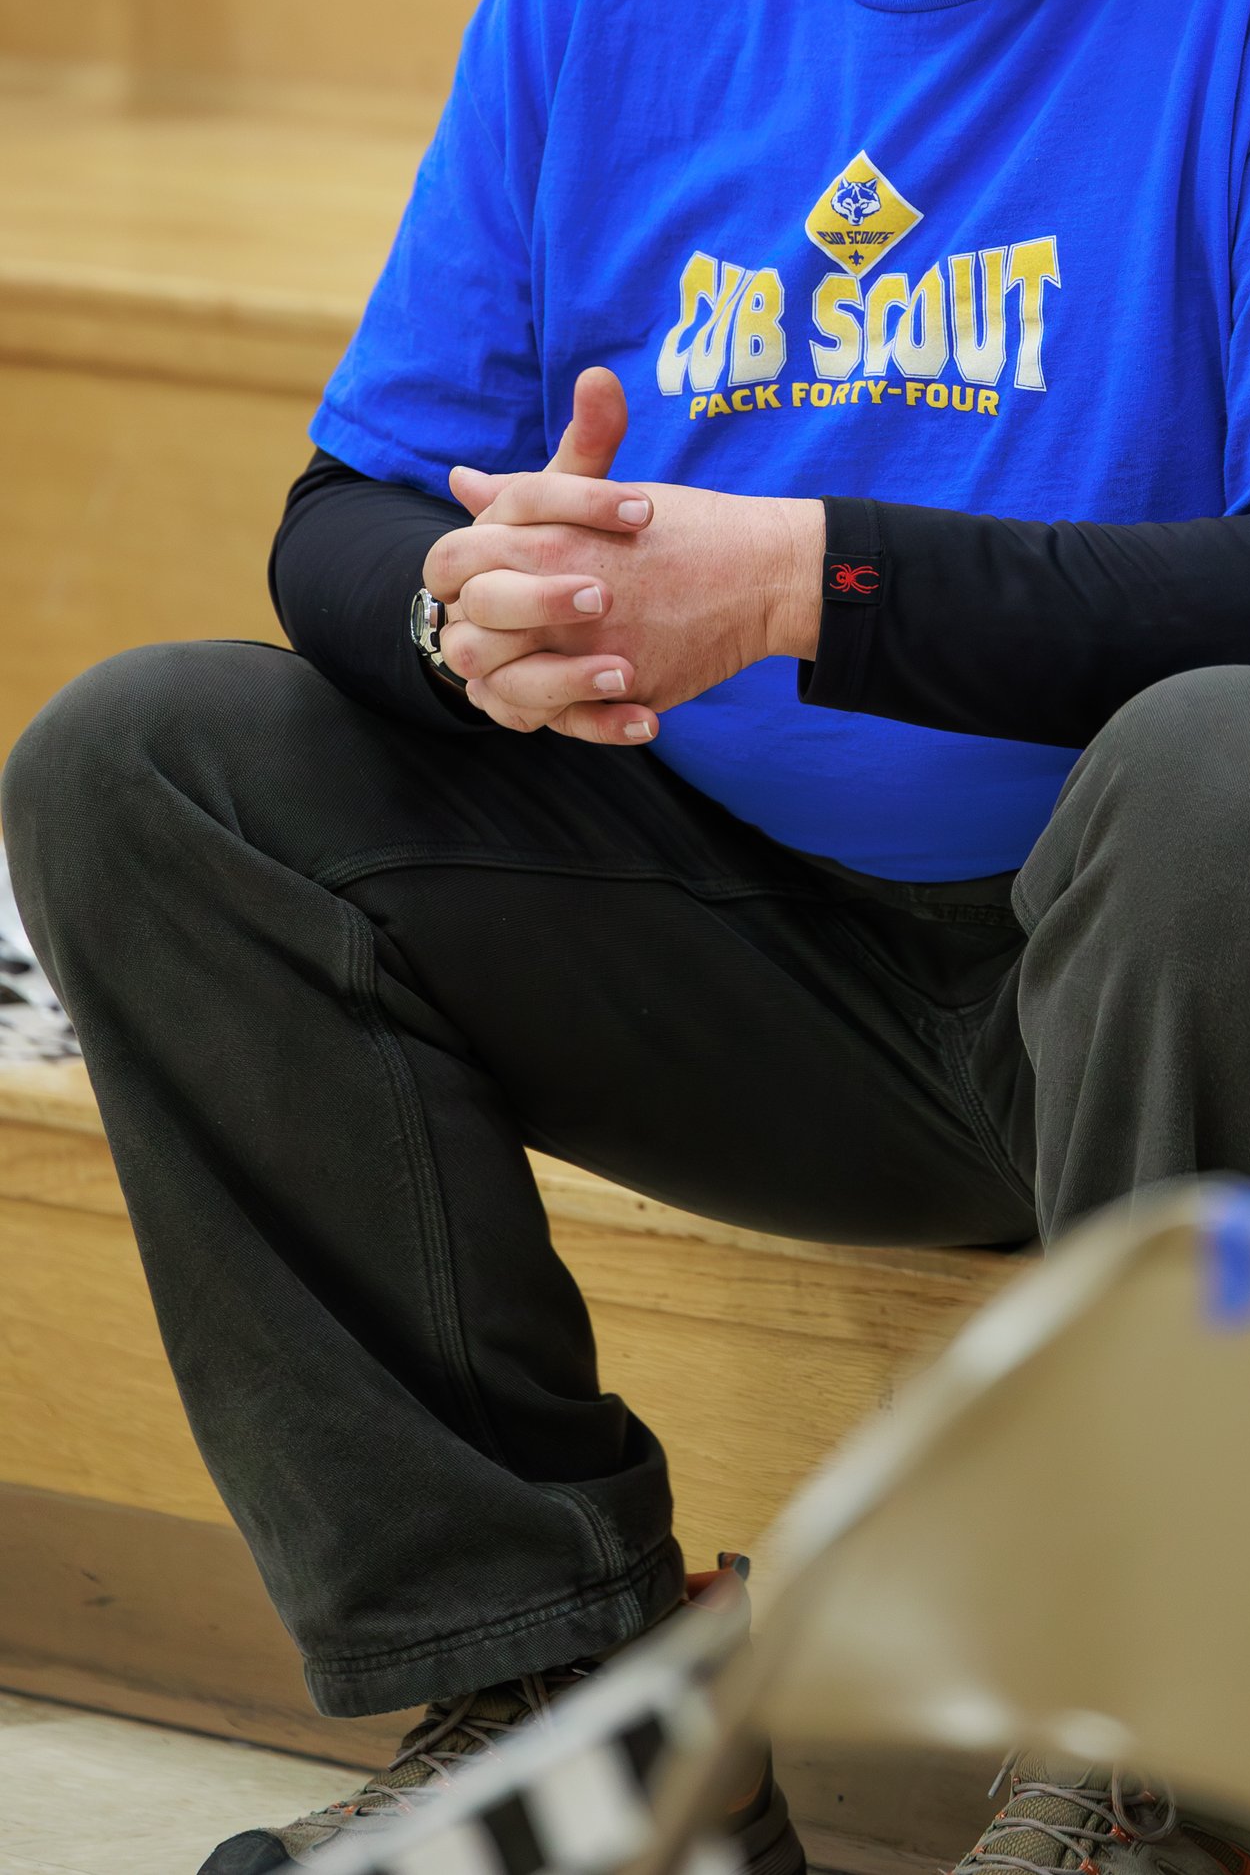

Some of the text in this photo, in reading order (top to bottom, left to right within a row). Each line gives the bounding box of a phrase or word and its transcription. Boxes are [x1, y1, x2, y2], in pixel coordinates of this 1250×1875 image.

[816, 230, 896, 245] CUB SCOUTS
[656, 235, 1061, 396] CUB SCOUT
[689, 380, 1000, 420] PACK FORTY-FOUR
